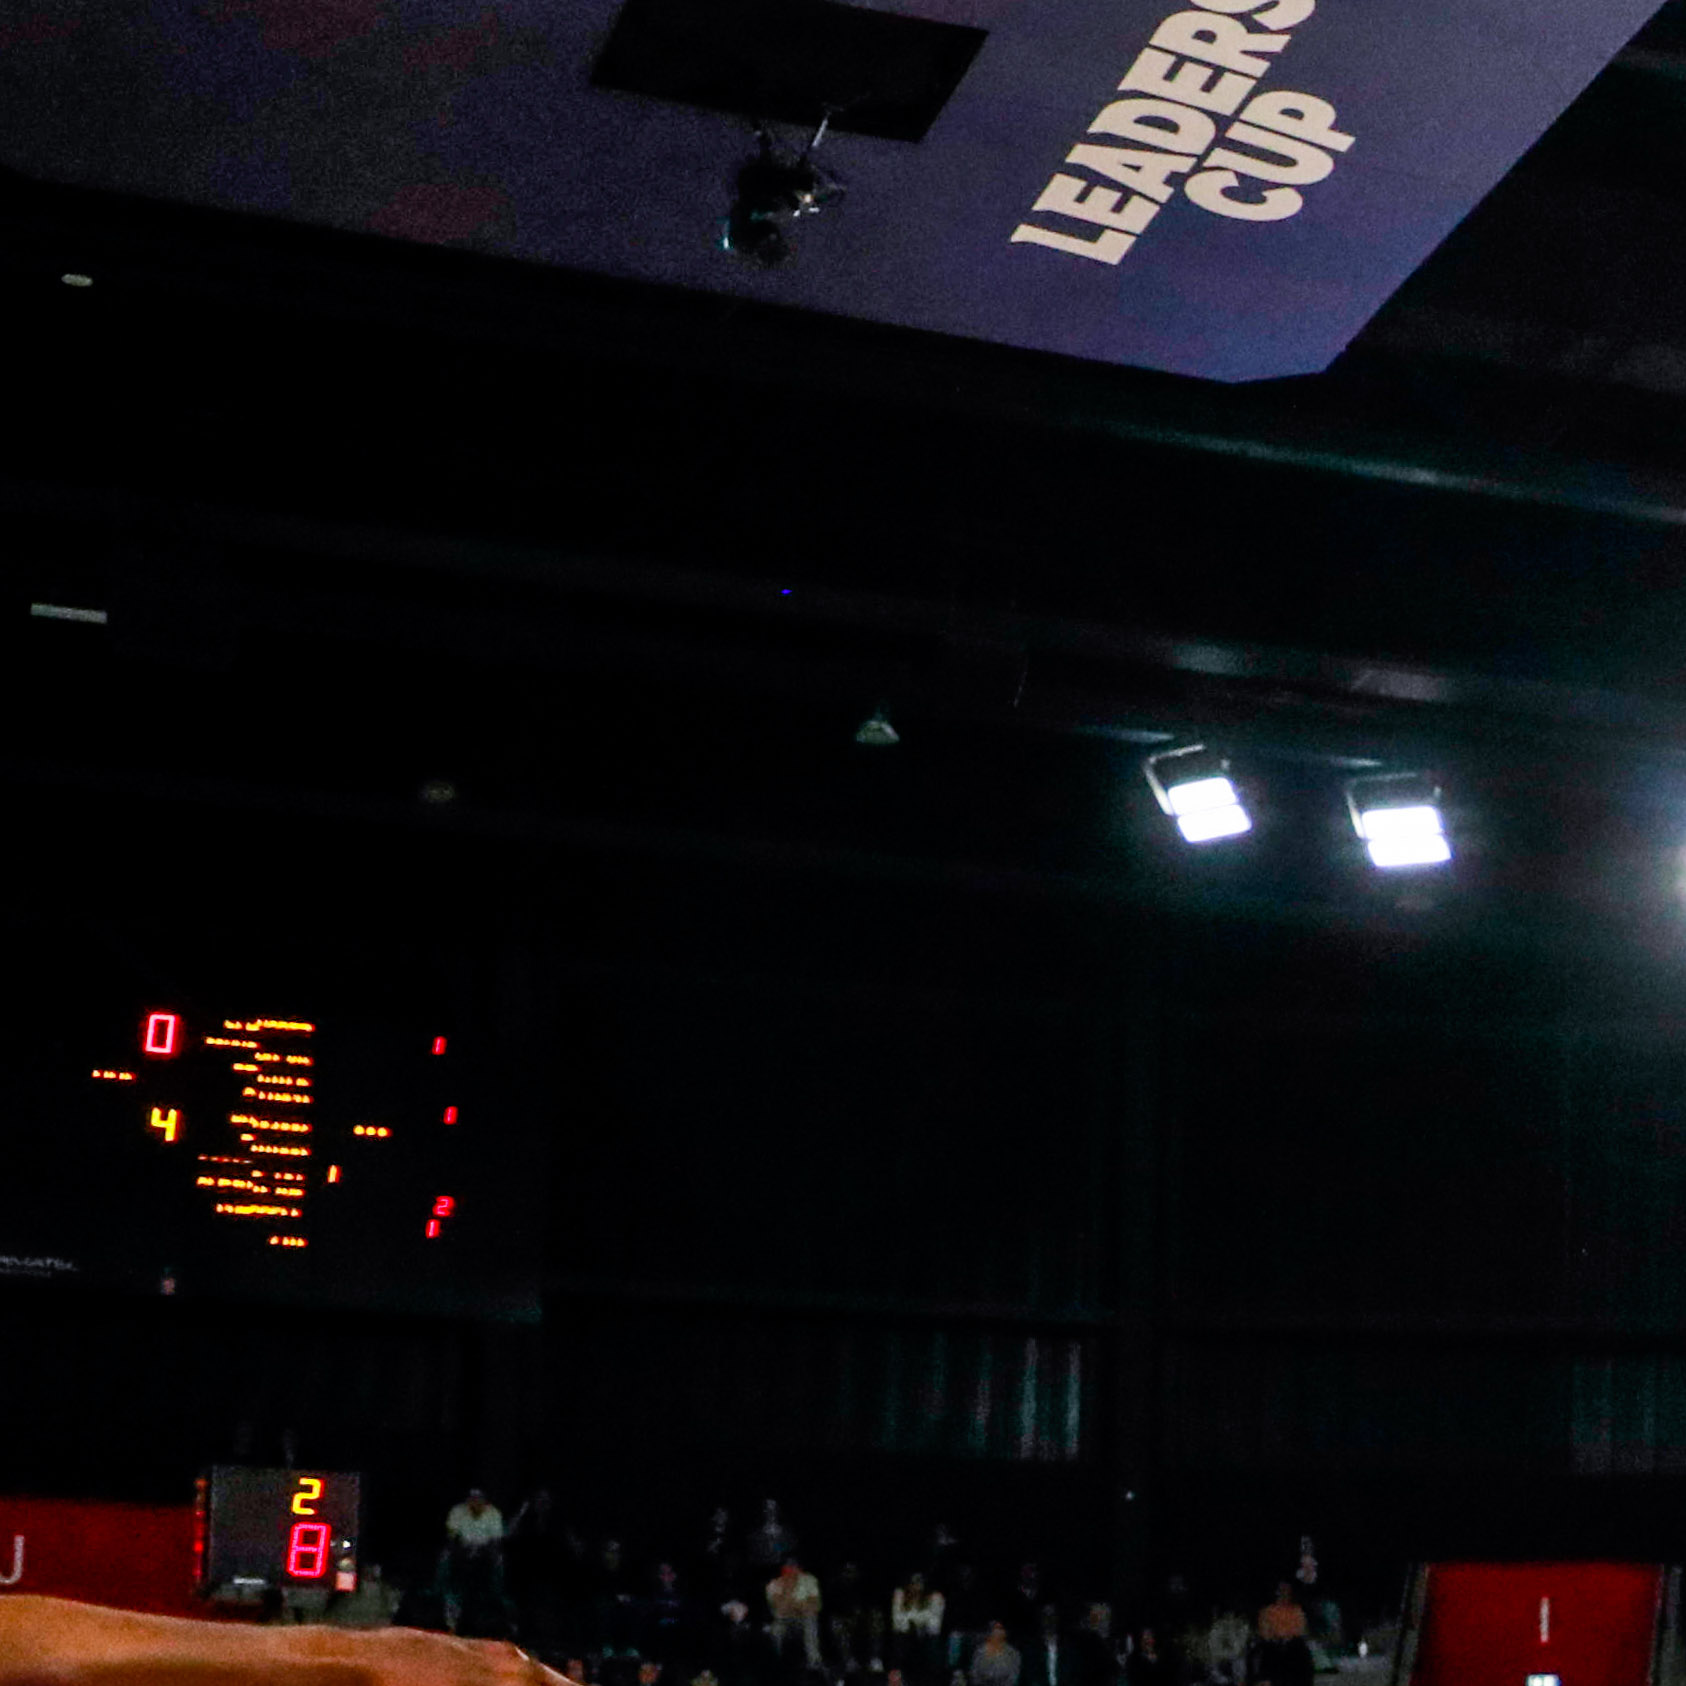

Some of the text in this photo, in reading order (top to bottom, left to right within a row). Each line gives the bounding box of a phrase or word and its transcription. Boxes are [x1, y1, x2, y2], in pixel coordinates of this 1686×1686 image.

[1184, 90, 1356, 223] CUP
[151, 1108, 178, 1141] 4
[291, 1477, 323, 1515] 2
